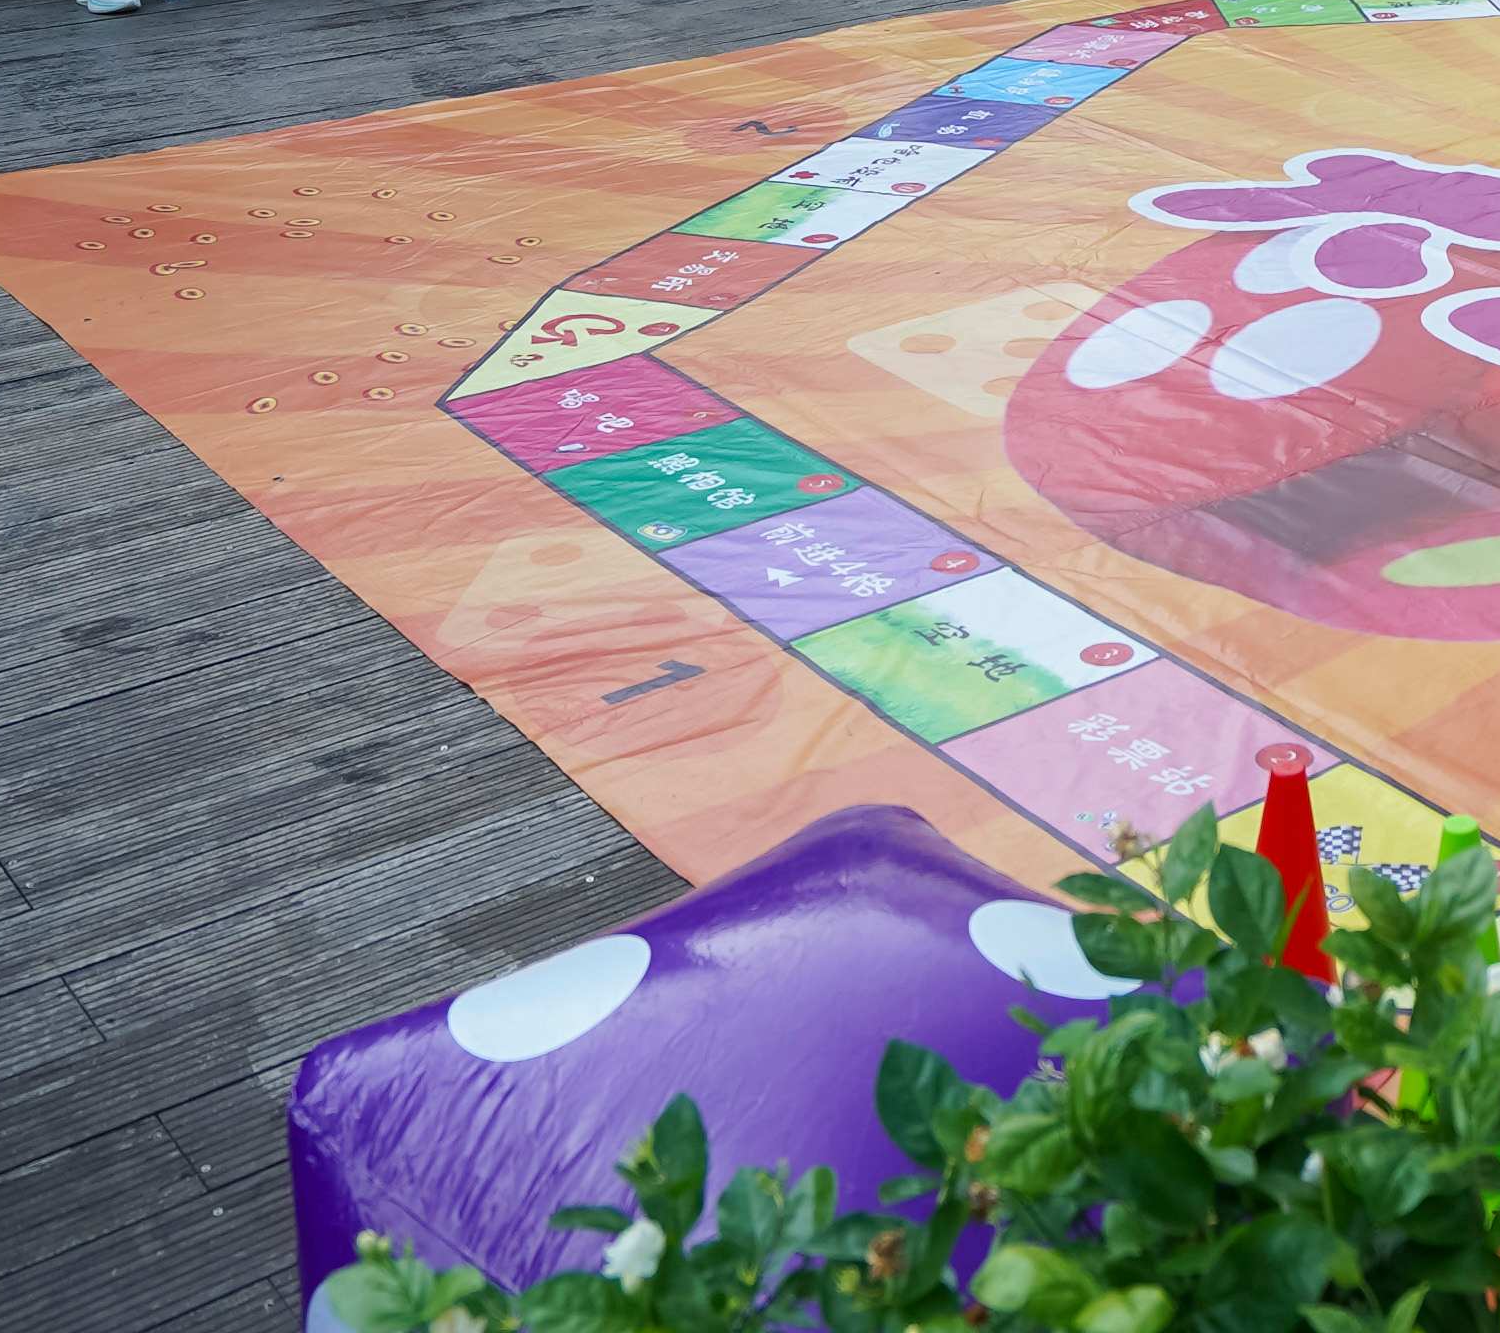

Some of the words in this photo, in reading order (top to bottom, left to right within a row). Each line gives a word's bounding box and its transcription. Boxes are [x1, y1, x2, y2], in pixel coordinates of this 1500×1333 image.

[650, 248, 740, 293] 交易所
[559, 388, 636, 435] 唱吧
[645, 451, 756, 513] 照相馆
[756, 520, 898, 599] 前进4格
[913, 620, 1030, 682] 空地
[1066, 710, 1213, 796] 彩票站
